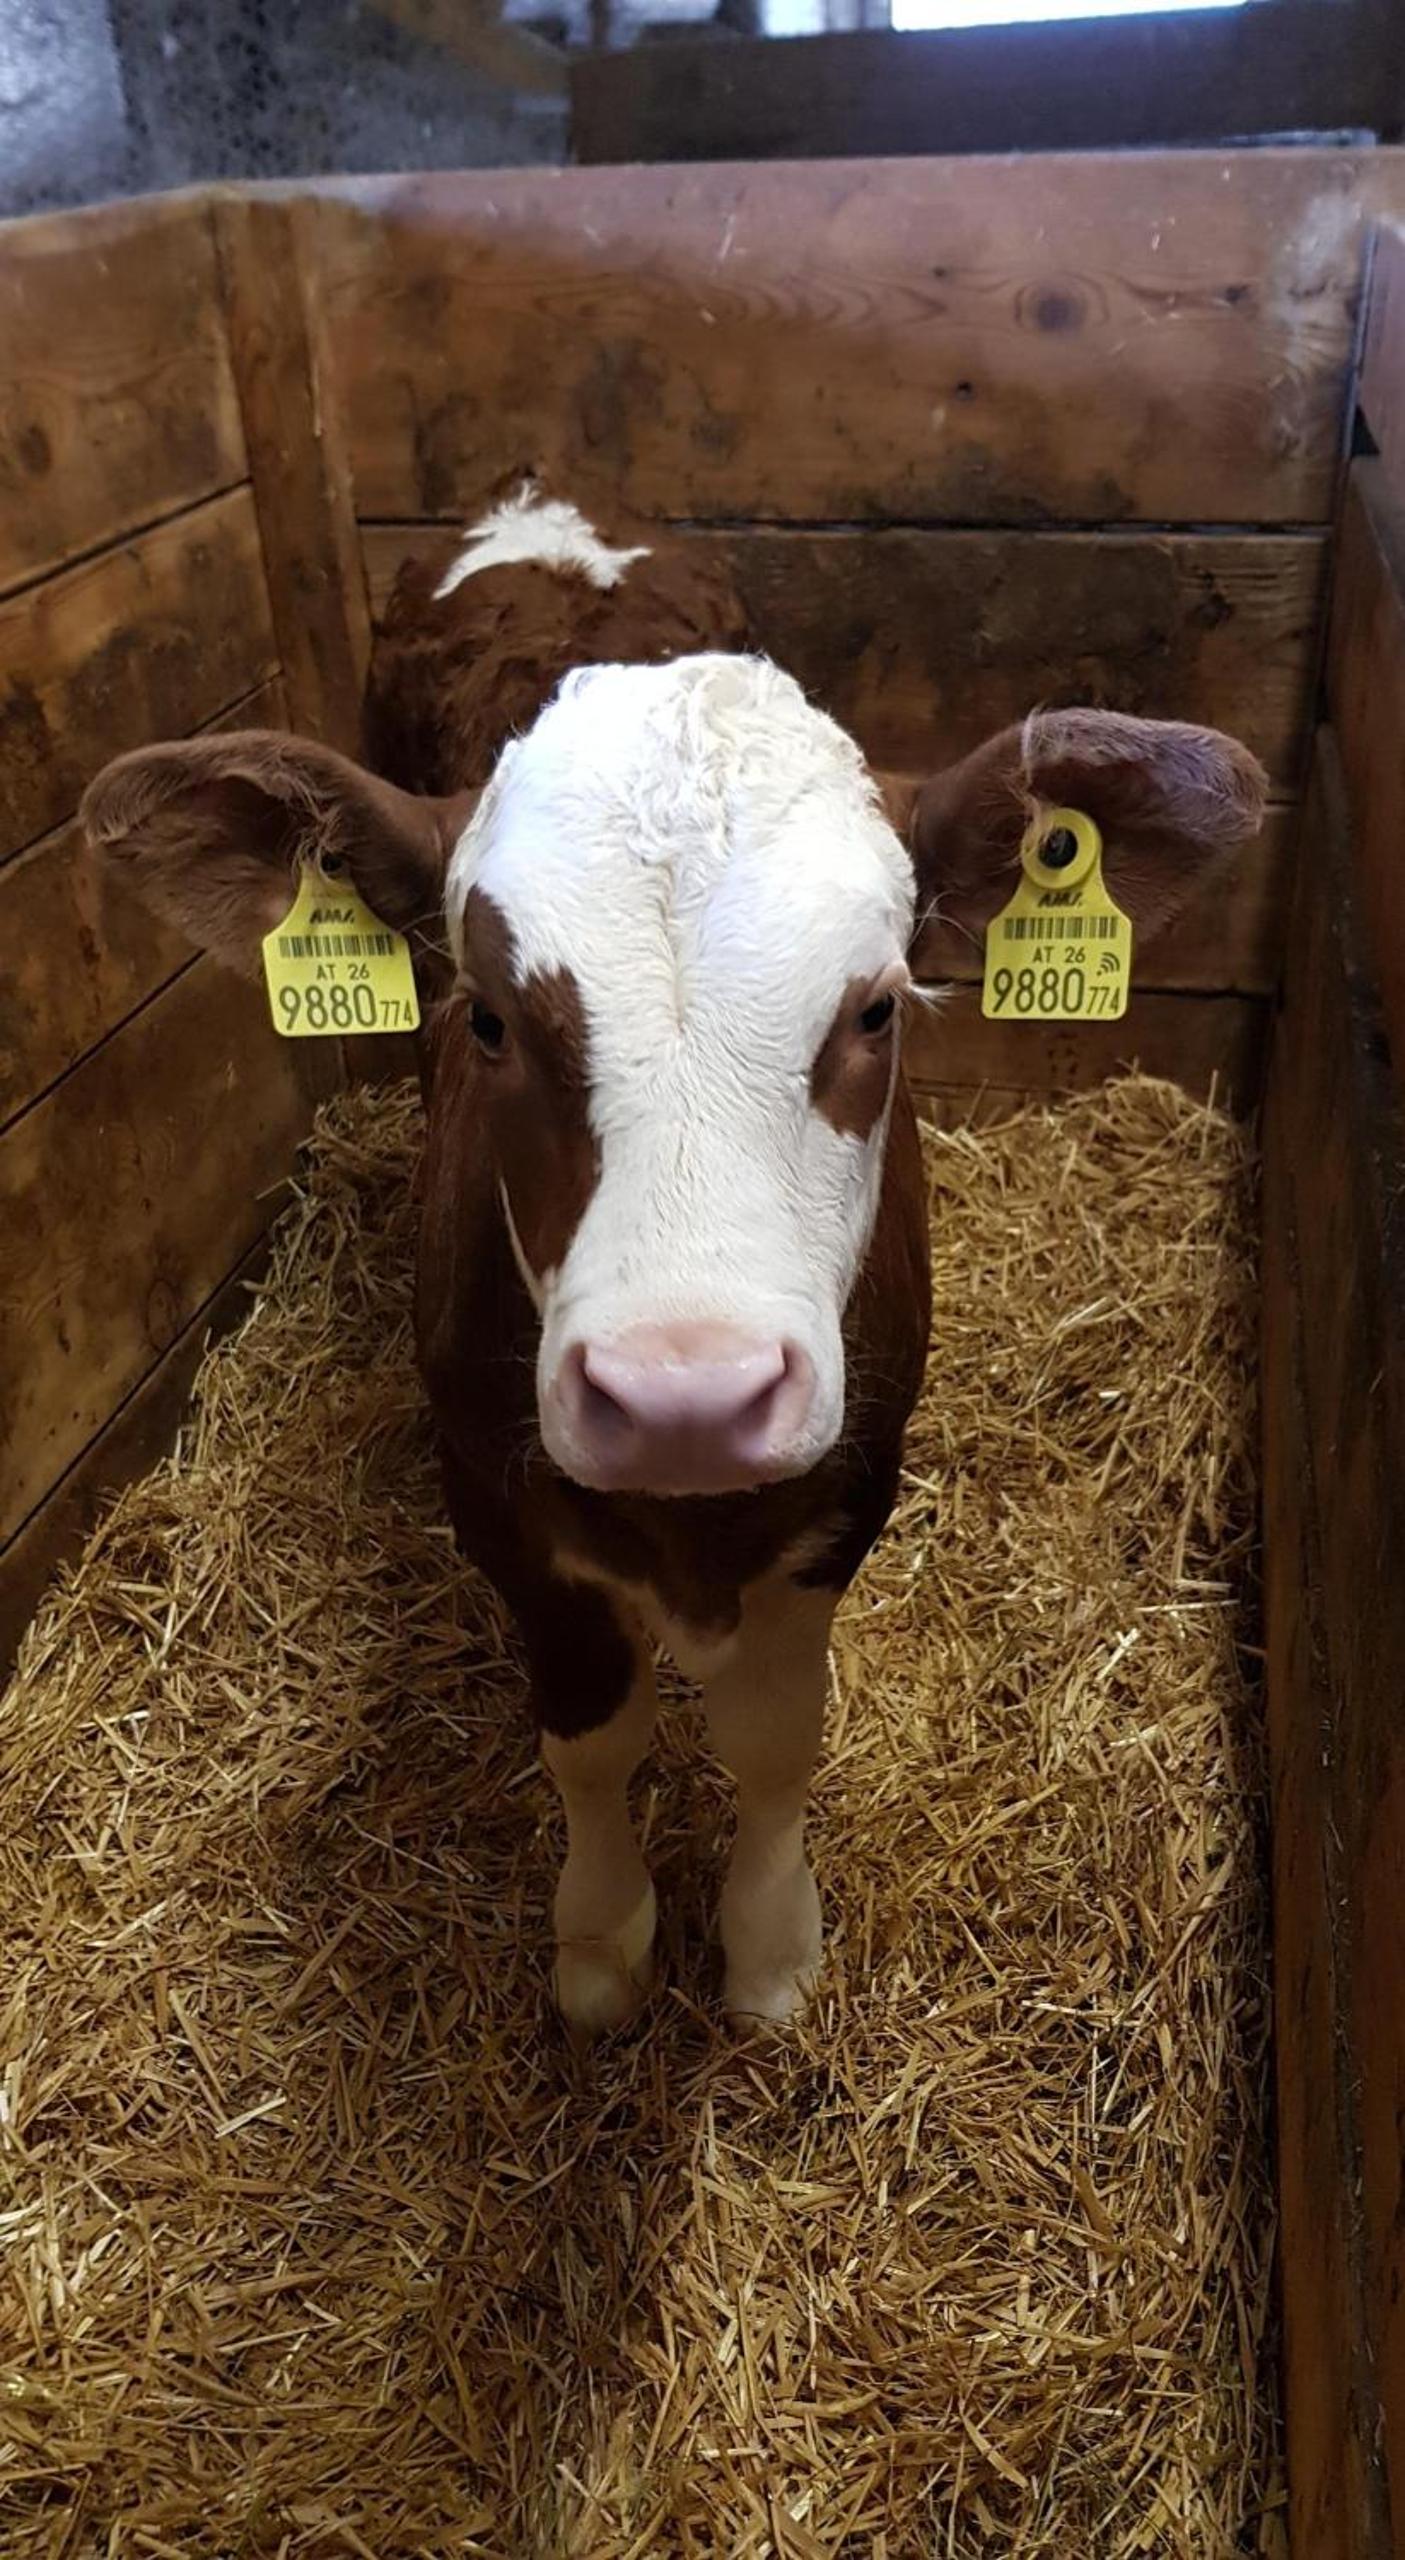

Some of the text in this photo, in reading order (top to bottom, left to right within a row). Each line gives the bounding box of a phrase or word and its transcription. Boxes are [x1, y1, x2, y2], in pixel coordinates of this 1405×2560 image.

[1032, 946, 1085, 964] AT 26
[316, 963, 370, 981] AT 26
[993, 967, 1121, 1014] 9880 774
[279, 984, 414, 1030] 9880 774
